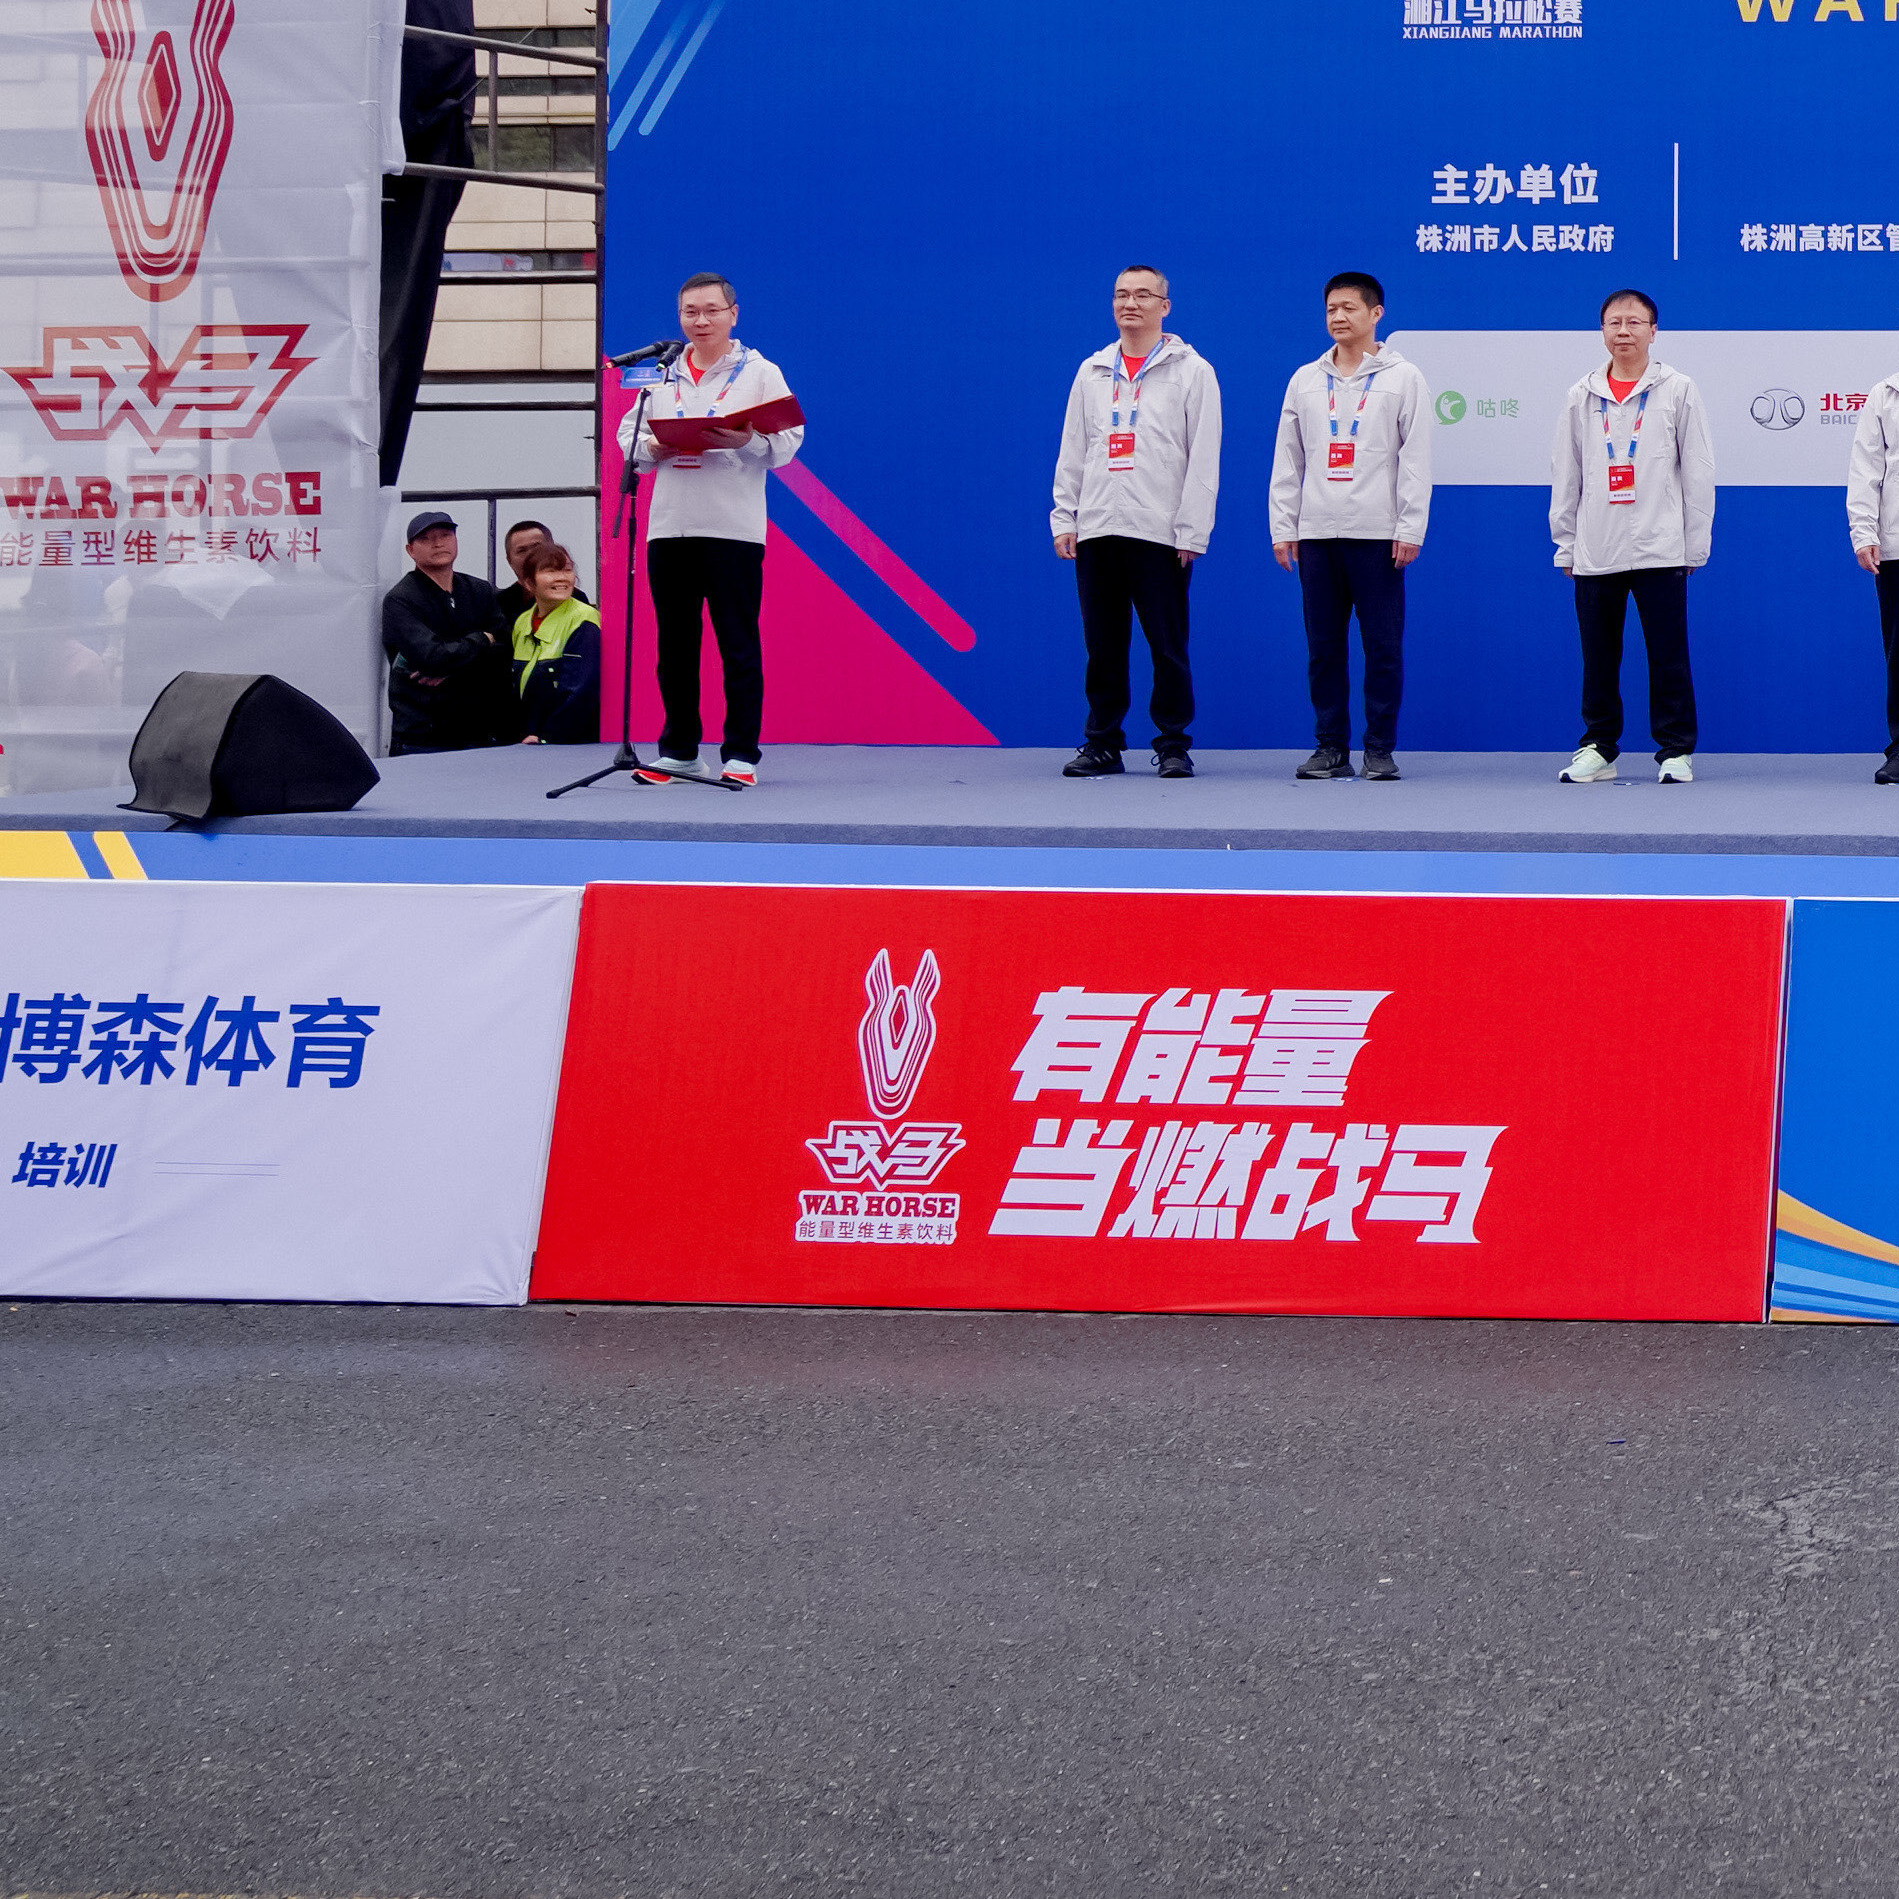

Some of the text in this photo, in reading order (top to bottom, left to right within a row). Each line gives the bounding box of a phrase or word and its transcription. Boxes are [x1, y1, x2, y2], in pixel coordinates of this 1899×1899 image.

[1402, 25, 1583, 40] XIANGJIANG MARATHON
[1431, 162, 1599, 205] 主办单位
[1415, 222, 1616, 254] 株洲市人民政府
[1476, 397, 1520, 419] 咕咚
[1820, 393, 1869, 411] 北京
[1820, 414, 1858, 425] BAIC
[0, 471, 322, 519] WAR HORSE
[0, 526, 322, 567] 能量型维生素饮料
[0, 991, 381, 1089] 博森体育
[1009, 985, 1396, 1107] 有能量
[11, 1140, 118, 1189] 培训
[987, 1117, 1510, 1245] 当燃战马
[803, 1194, 956, 1219] WAR HORSE
[799, 1219, 954, 1241] 能量型维生素饮料
